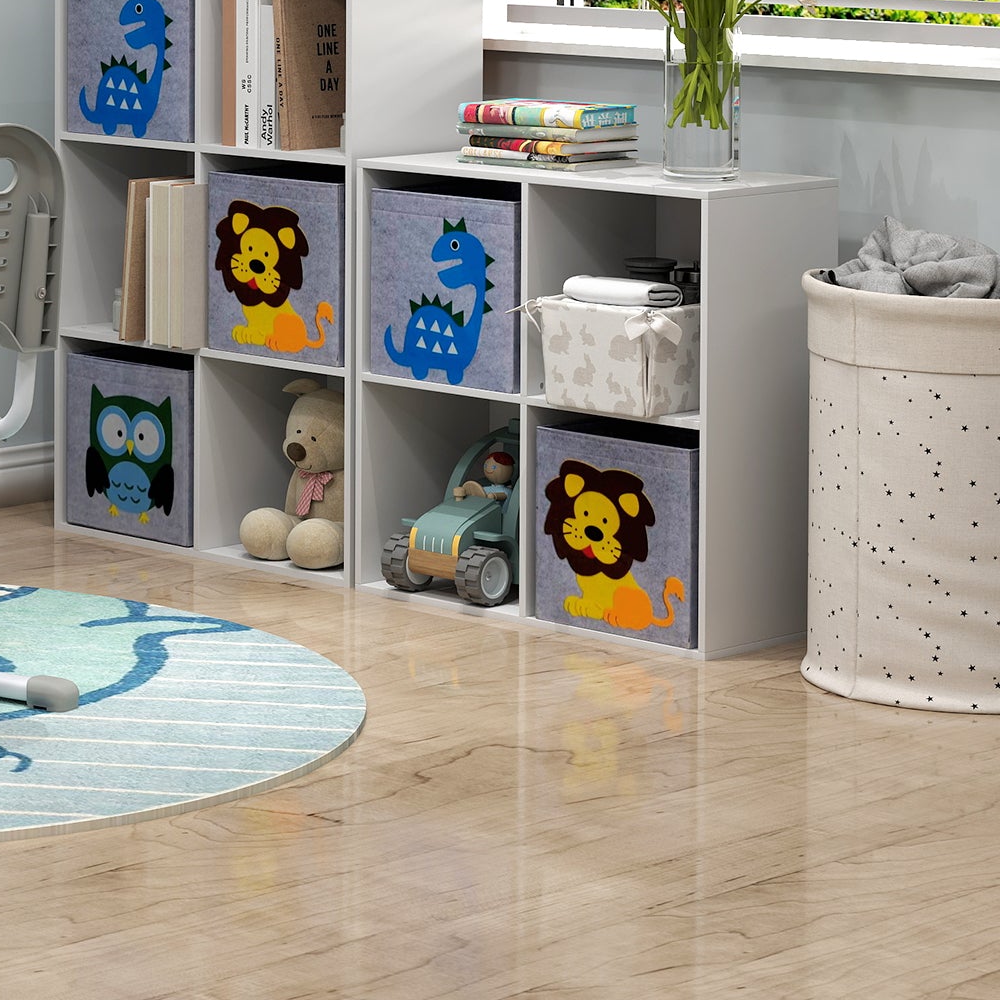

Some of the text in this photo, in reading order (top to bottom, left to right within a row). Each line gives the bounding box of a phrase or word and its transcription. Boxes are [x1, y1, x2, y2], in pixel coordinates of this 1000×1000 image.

[317, 23, 337, 38] ONE
[316, 41, 340, 56] LINE
[325, 60, 333, 74] A
[320, 77, 340, 92] DAY
